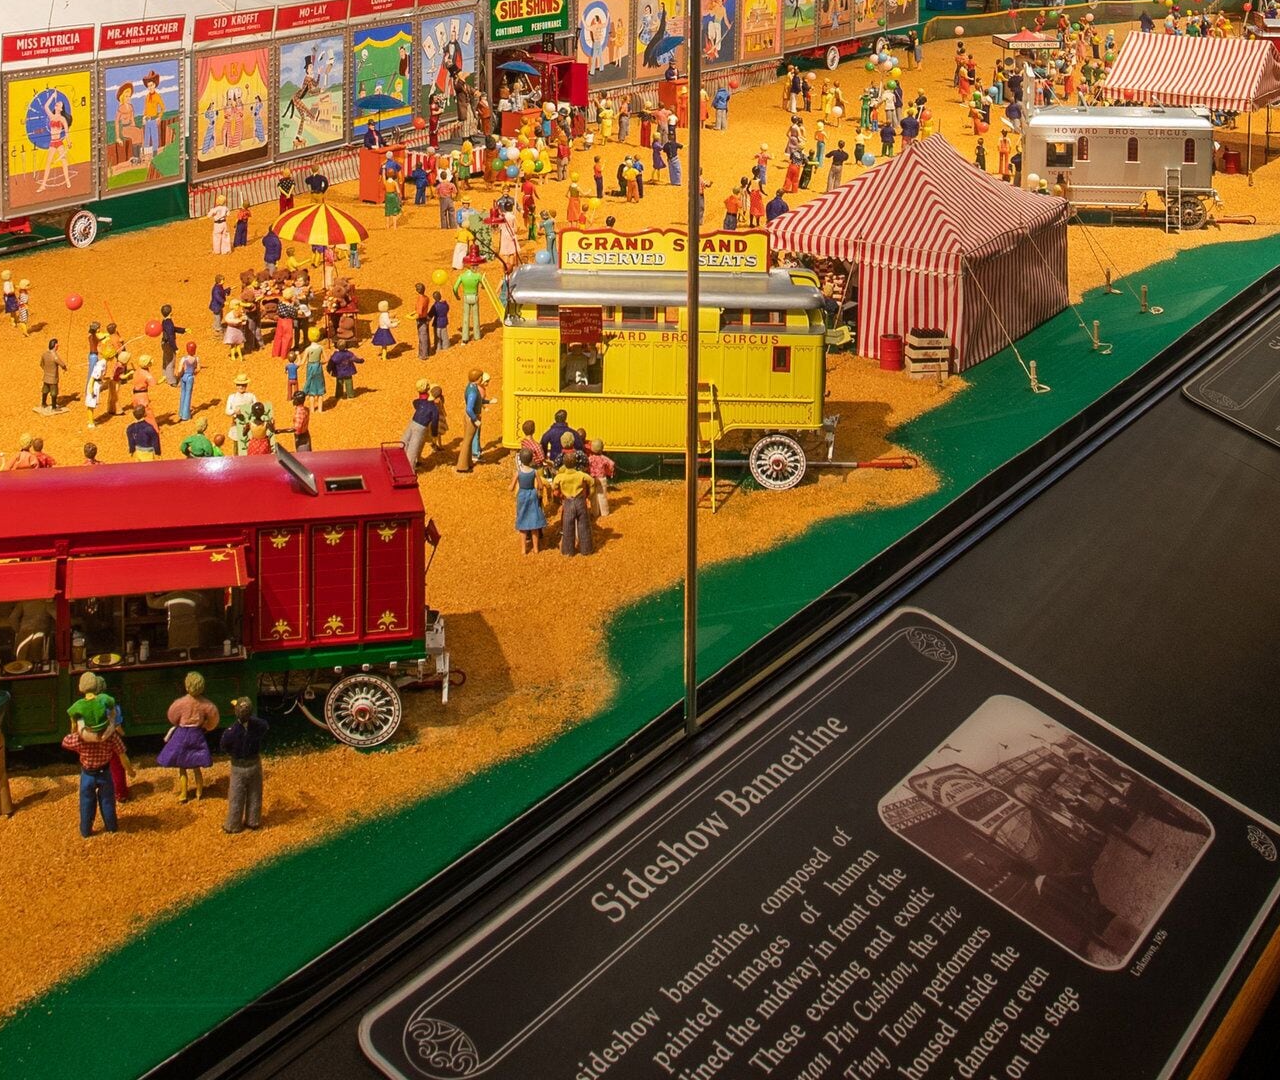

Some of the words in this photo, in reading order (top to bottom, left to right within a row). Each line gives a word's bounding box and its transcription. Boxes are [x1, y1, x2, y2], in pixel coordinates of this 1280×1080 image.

[125, 25, 145, 38] MRS.
[145, 22, 178, 35] FISCHER
[213, 16, 227, 29] SID
[231, 12, 259, 26] KROFFT
[299, 4, 328, 18] MO-LAY
[500, 1, 524, 20] SIDE
[531, 19, 562, 32] PERFORMANCE
[16, 37, 38, 51] MISS
[40, 32, 80, 48] PATRICIA
[1109, 128, 1138, 136] BROS.
[1148, 129, 1187, 137] CIRCUS
[567, 252, 666, 266] RESERVED
[697, 252, 757, 267] SEATS
[578, 237, 654, 251] GRAND
[673, 238, 748, 253] SAND
[723, 334, 779, 345] CIRCUS
[591, 811, 729, 923] Sideshow
[715, 716, 848, 817] Bannerline
[576, 1008, 660, 1080] sideshow
[660, 923, 759, 1003] bannerline,
[761, 847, 831, 914] composed
[833, 826, 852, 846] of
[653, 998, 722, 1074] painted
[728, 936, 790, 990] images
[800, 900, 821, 923] of
[824, 850, 879, 895] human
[726, 1018, 760, 1046] the
[756, 957, 821, 1019] midway
[809, 941, 836, 959] in
[828, 904, 870, 941] front
[866, 884, 885, 906] of
[877, 869, 906, 890] the
[749, 1025, 805, 1073] These
[807, 961, 870, 1021] exciting
[865, 925, 895, 959] and
[894, 887, 934, 926] exotic
[823, 1022, 858, 1053] Pin
[853, 962, 918, 1020] Cushion,
[908, 935, 937, 958] the
[929, 906, 961, 934] Fire
[844, 1047, 890, 1080] Tiny
[879, 1002, 925, 1045] Town
[923, 927, 990, 1006] performers
[898, 1019, 957, 1080] housed
[949, 974, 997, 1021] inside
[991, 947, 1019, 971] the
[954, 1018, 1008, 1078] dancers
[1003, 999, 1022, 1019] or
[1017, 967, 1049, 1001] even
[1006, 1056, 1029, 1078] on
[1020, 1027, 1049, 1053] the
[1045, 987, 1079, 1026] stage
